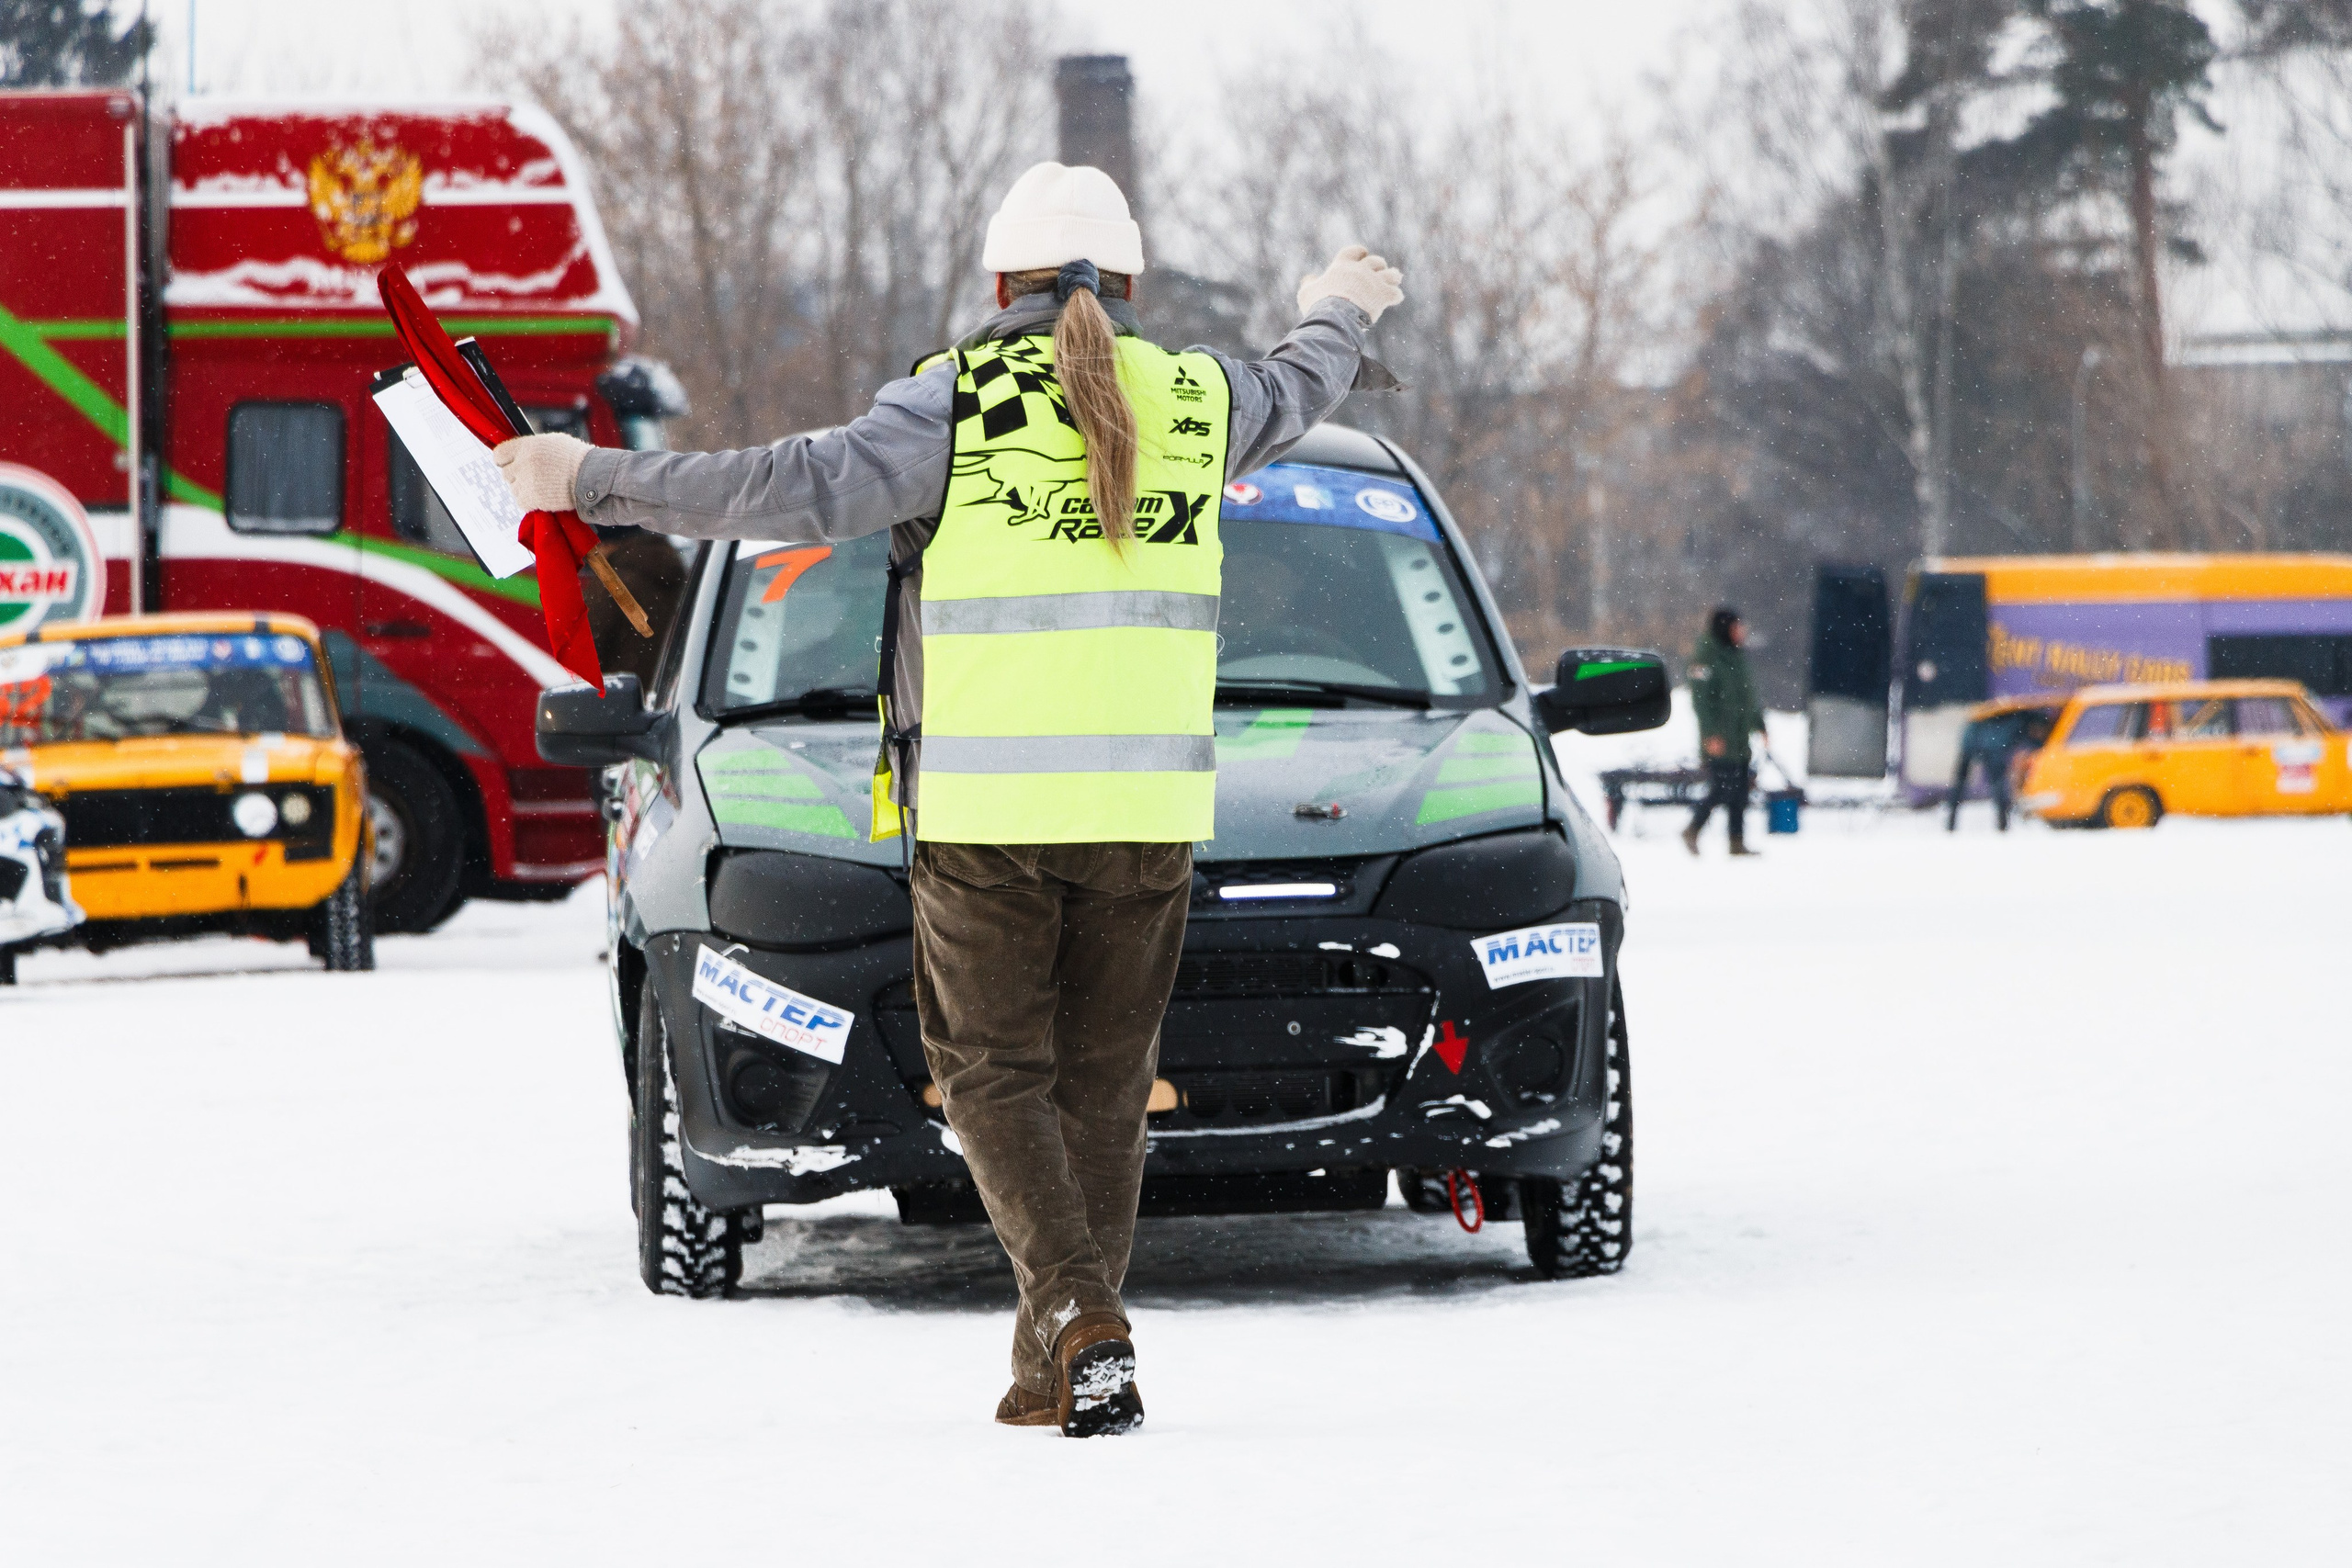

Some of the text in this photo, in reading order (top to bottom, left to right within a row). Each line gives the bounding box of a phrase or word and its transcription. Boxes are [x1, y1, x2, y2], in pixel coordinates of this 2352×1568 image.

[1170, 388, 1206, 396] MITSUBISHI
[1169, 417, 1212, 436] XPS
[755, 546, 832, 604] 7
[1487, 929, 1597, 964] МАСТЕР
[698, 953, 846, 1031] МАСТЕР
[759, 1016, 828, 1052] СПОРТ
